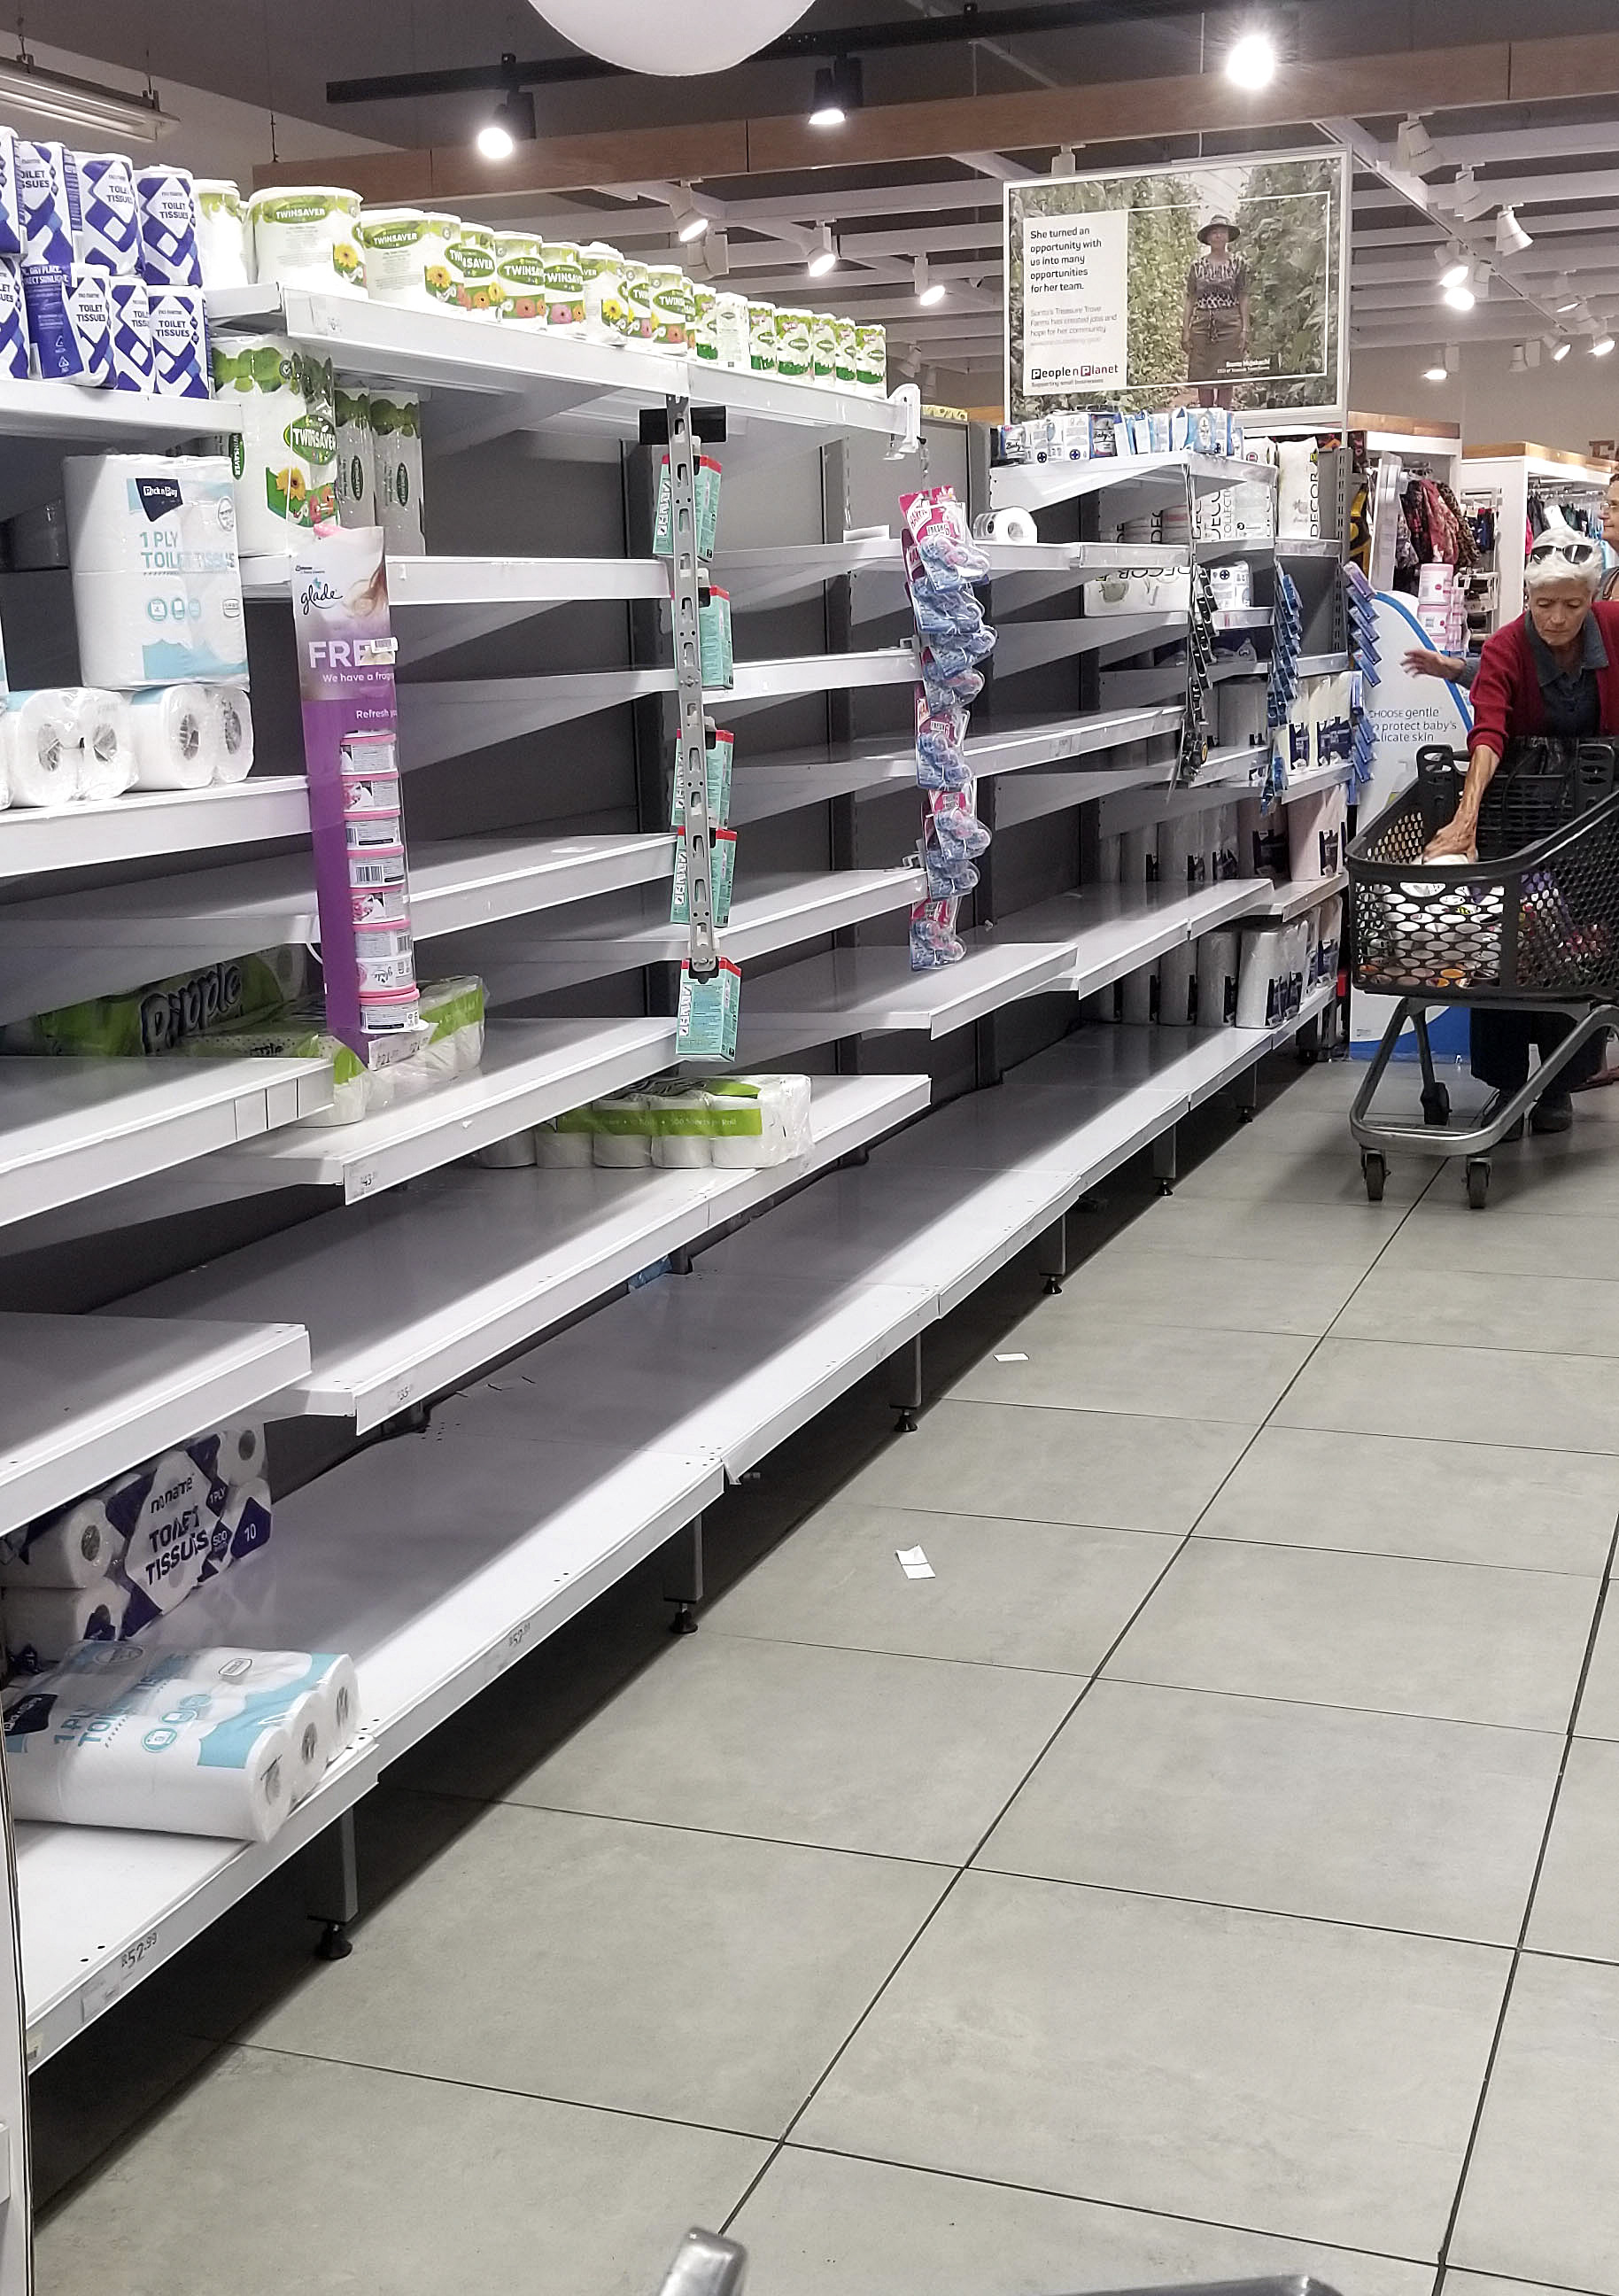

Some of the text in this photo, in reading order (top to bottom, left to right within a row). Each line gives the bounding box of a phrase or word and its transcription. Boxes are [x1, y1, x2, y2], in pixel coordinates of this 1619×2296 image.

[276, 207, 326, 220] TWINSAVER
[373, 232, 418, 244] TWINSAVER
[1030, 230, 1047, 239] She
[1050, 227, 1078, 237] turned
[1030, 239, 1102, 254] opportunity with
[1062, 255, 1085, 265] many
[1030, 268, 1088, 281] opportunities
[1031, 283, 1084, 293] for her team.
[78, 304, 103, 313] TOILET
[76, 314, 106, 322] TISSUES
[156, 329, 190, 337] TISSUES
[1031, 366, 1071, 380] People
[1081, 364, 1119, 376] Planet
[140, 531, 178, 547] 1 PLY
[301, 583, 344, 615] glade
[322, 673, 339, 684] We
[340, 672, 365, 683] have
[356, 709, 389, 719] Refresh
[1405, 706, 1439, 719] gentle
[1383, 721, 1420, 733] protect
[1423, 720, 1458, 733] baby's
[1412, 732, 1434, 742] skin
[244, 1523, 257, 1543] 10
[145, 1529, 210, 1586] TISSUES
